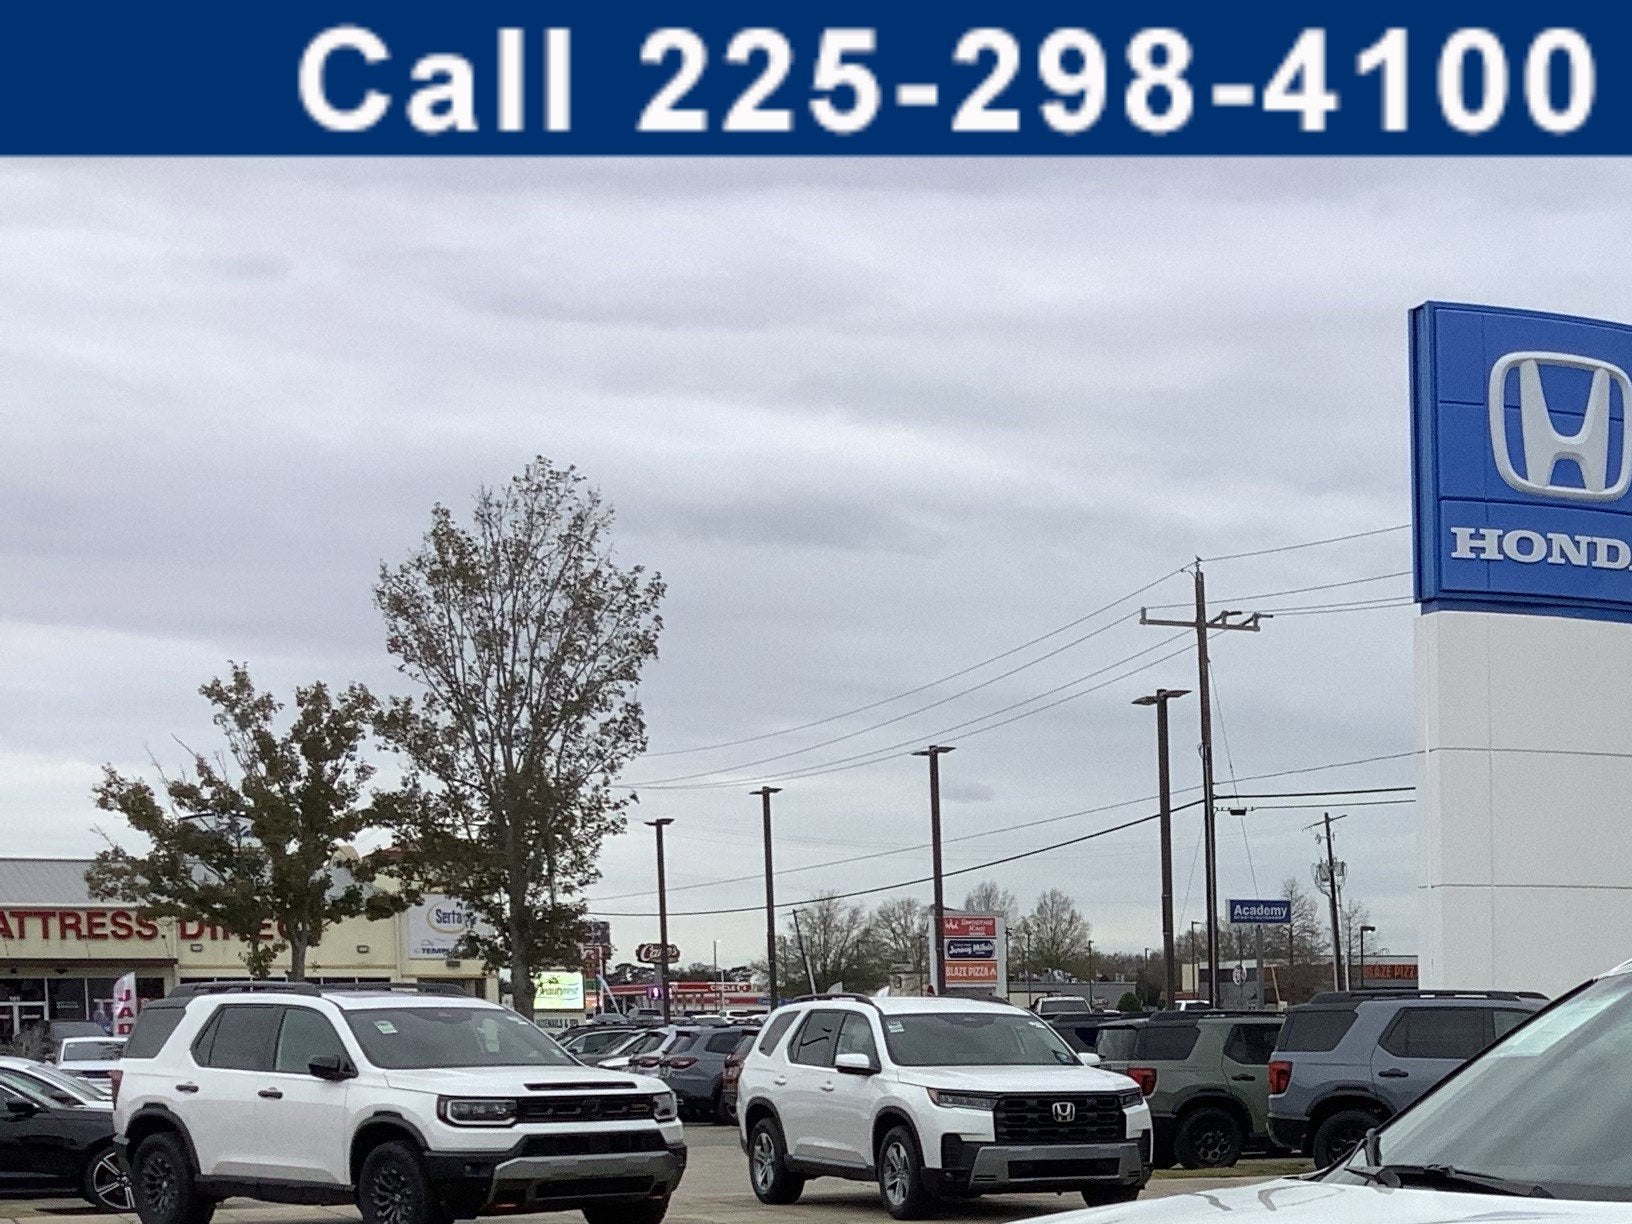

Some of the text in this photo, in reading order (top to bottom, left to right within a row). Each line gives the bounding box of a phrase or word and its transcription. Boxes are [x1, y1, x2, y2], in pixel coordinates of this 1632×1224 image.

[435, 908, 463, 925] Serta
[1233, 904, 1288, 919] Academy
[968, 966, 989, 977] PIZZA
